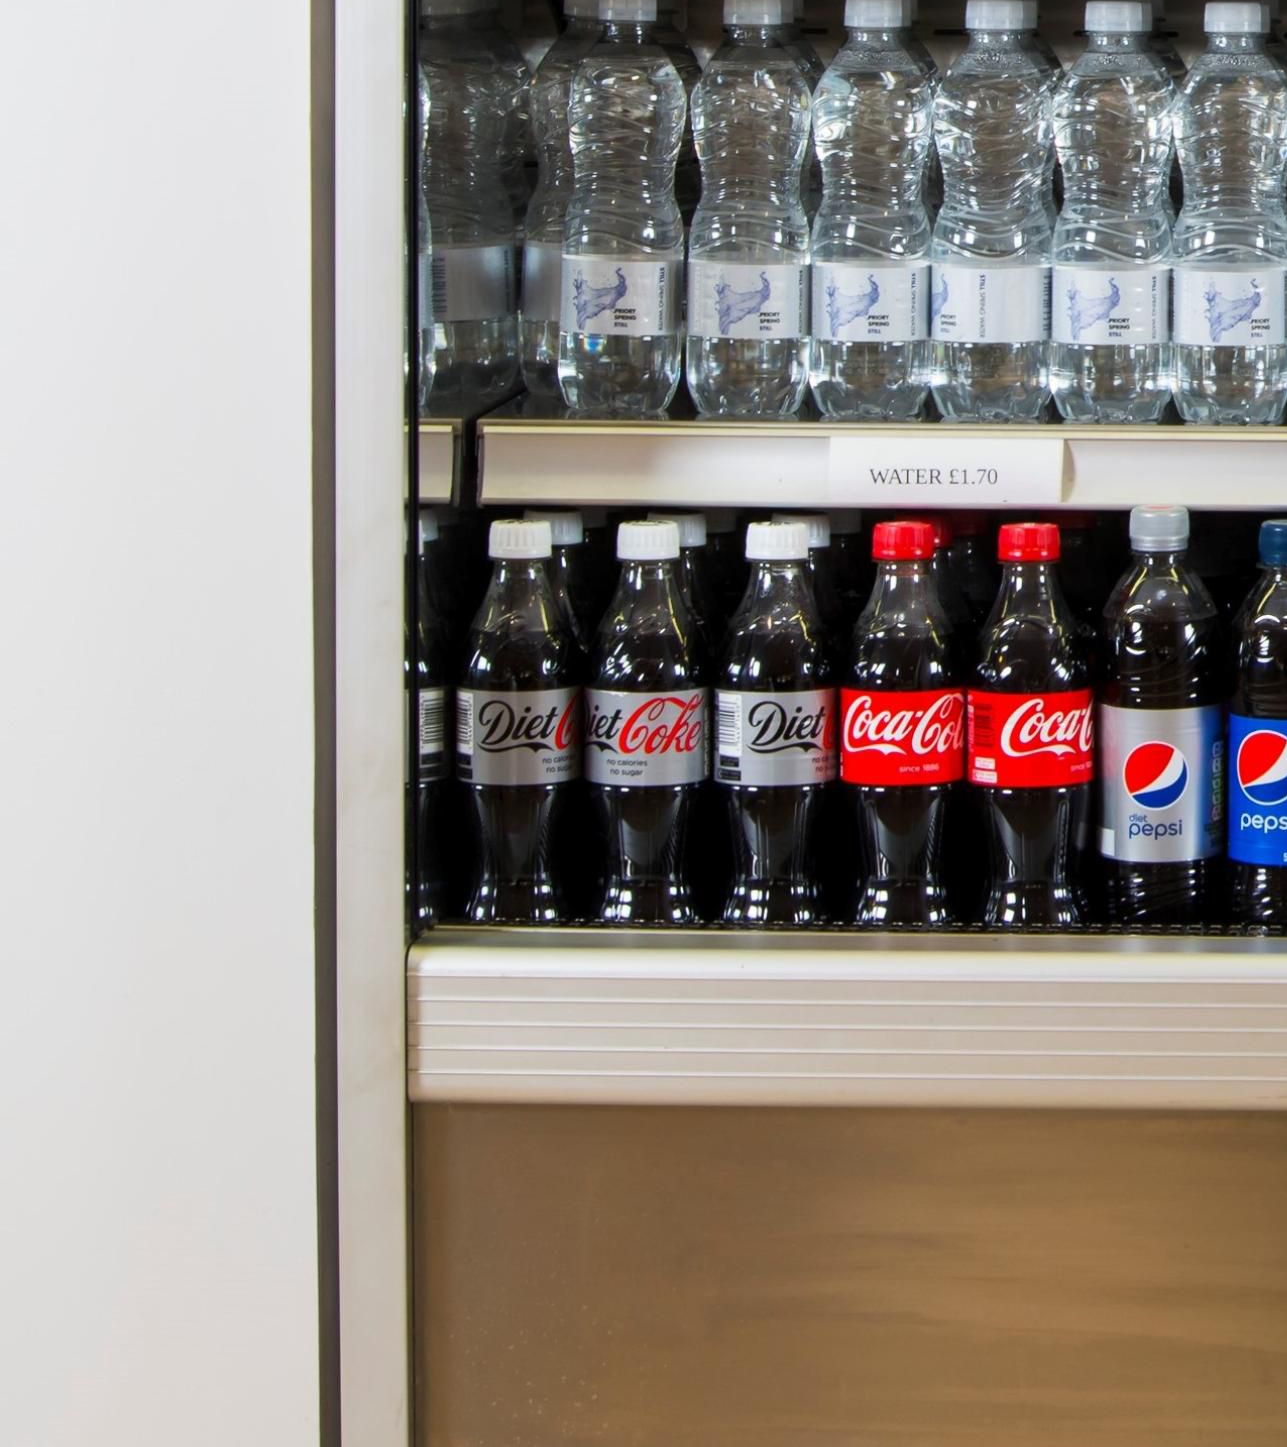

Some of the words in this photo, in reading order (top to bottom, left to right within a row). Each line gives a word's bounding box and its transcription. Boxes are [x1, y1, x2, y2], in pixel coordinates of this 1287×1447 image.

[869, 468, 942, 485] WATER
[949, 468, 998, 486] £1.70
[477, 700, 557, 753] Diet
[618, 693, 704, 754] Coke
[747, 700, 827, 754] Diet
[606, 759, 615, 767] no
[616, 758, 648, 767] calories
[620, 768, 643, 778] sugar
[1128, 819, 1184, 840] pepsi
